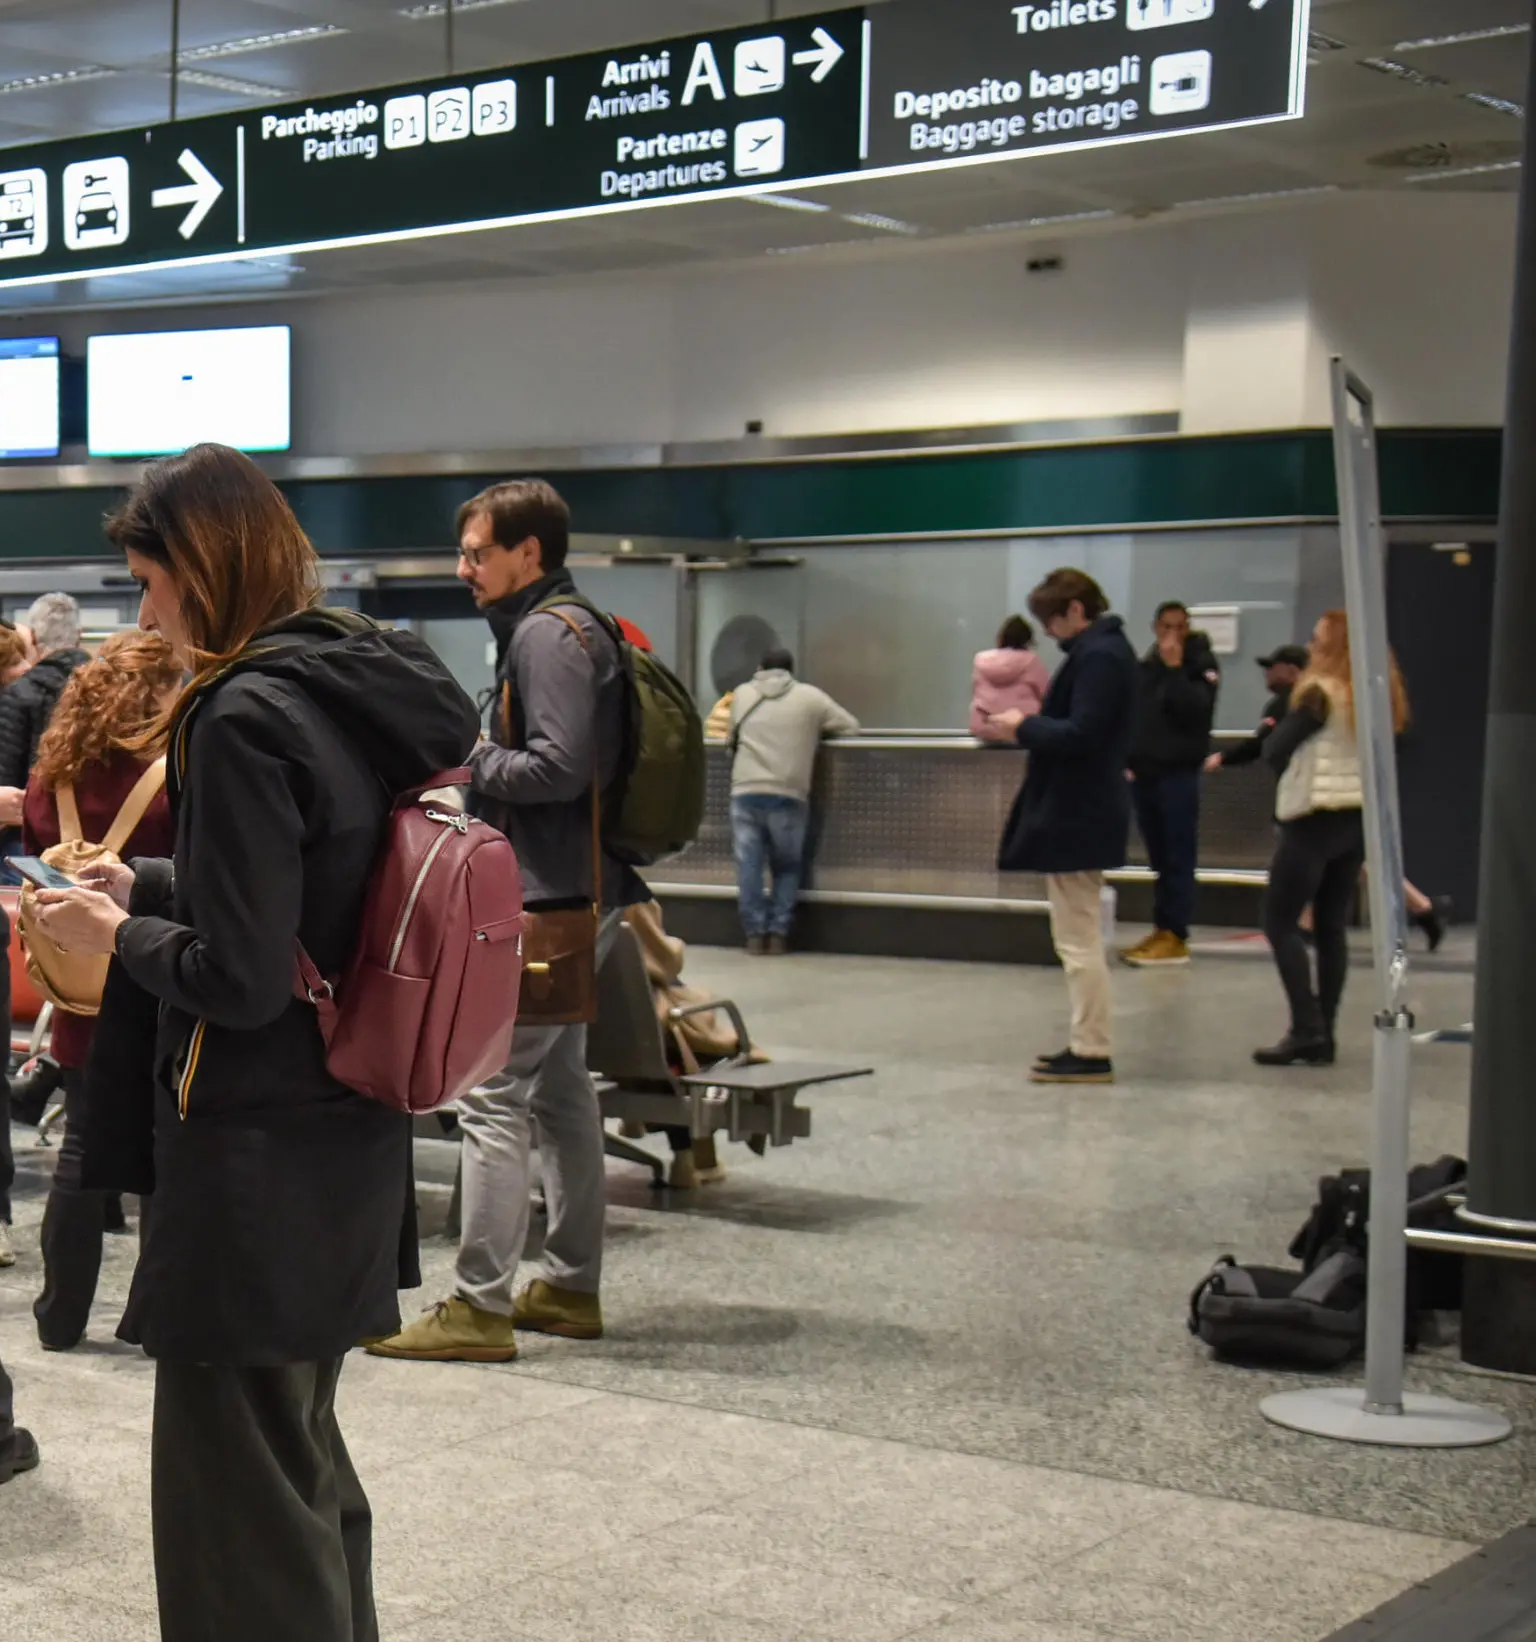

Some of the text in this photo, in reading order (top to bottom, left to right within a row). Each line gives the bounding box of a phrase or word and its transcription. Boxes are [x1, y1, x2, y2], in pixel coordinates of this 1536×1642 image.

[1011, 0, 1117, 34] Toilets
[602, 50, 670, 87] Arrivi
[680, 41, 726, 106] A
[894, 55, 1140, 119] Deposito bagagli
[262, 99, 379, 140] Parcheggio
[391, 101, 509, 141] P1 P2 P3
[585, 84, 670, 121] Arrivals
[617, 128, 727, 162] Partenze
[910, 98, 1139, 152] Baggage storage
[303, 131, 378, 162] Parking
[601, 157, 727, 197] Departures
